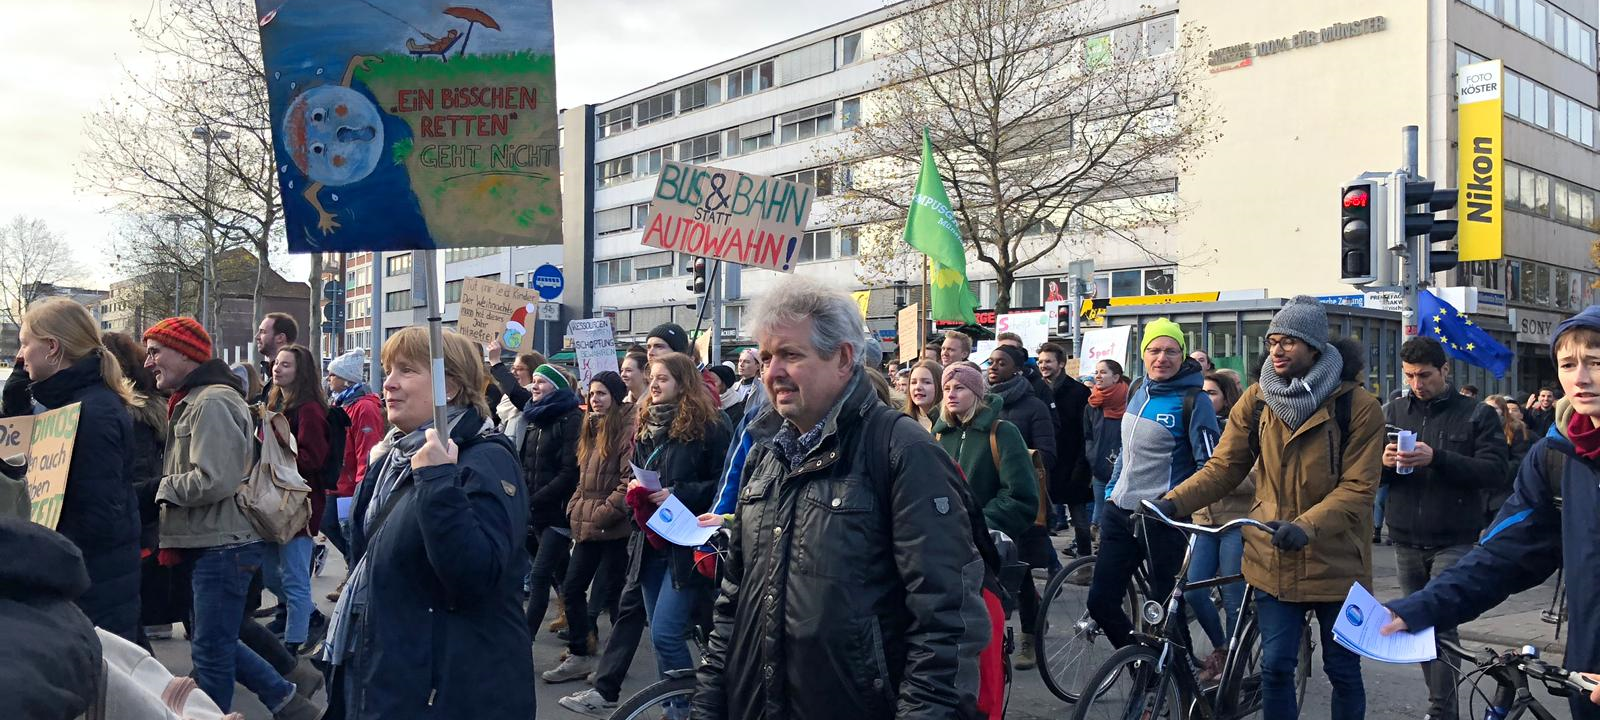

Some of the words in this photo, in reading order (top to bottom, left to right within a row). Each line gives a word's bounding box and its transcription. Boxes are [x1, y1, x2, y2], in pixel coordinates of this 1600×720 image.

[1255, 37, 1292, 57] 100%
[1292, 30, 1319, 49] FÜR
[1320, 15, 1387, 43] MÜNSTER
[1466, 72, 1493, 84] FOTO
[1461, 82, 1497, 96] KÖSTER
[420, 144, 481, 169] GEHT
[1466, 136, 1493, 224] Nikon
[656, 163, 711, 207] BUS
[705, 172, 732, 211] &
[731, 175, 809, 227] BAHN
[694, 206, 733, 226] STATT
[462, 293, 474, 305] Der
[472, 318, 489, 328] Jahr
[1521, 318, 1552, 336] SONY
[1088, 343, 1115, 359] Sport
[32, 404, 80, 446] DINOS
[40, 442, 66, 472] auch
